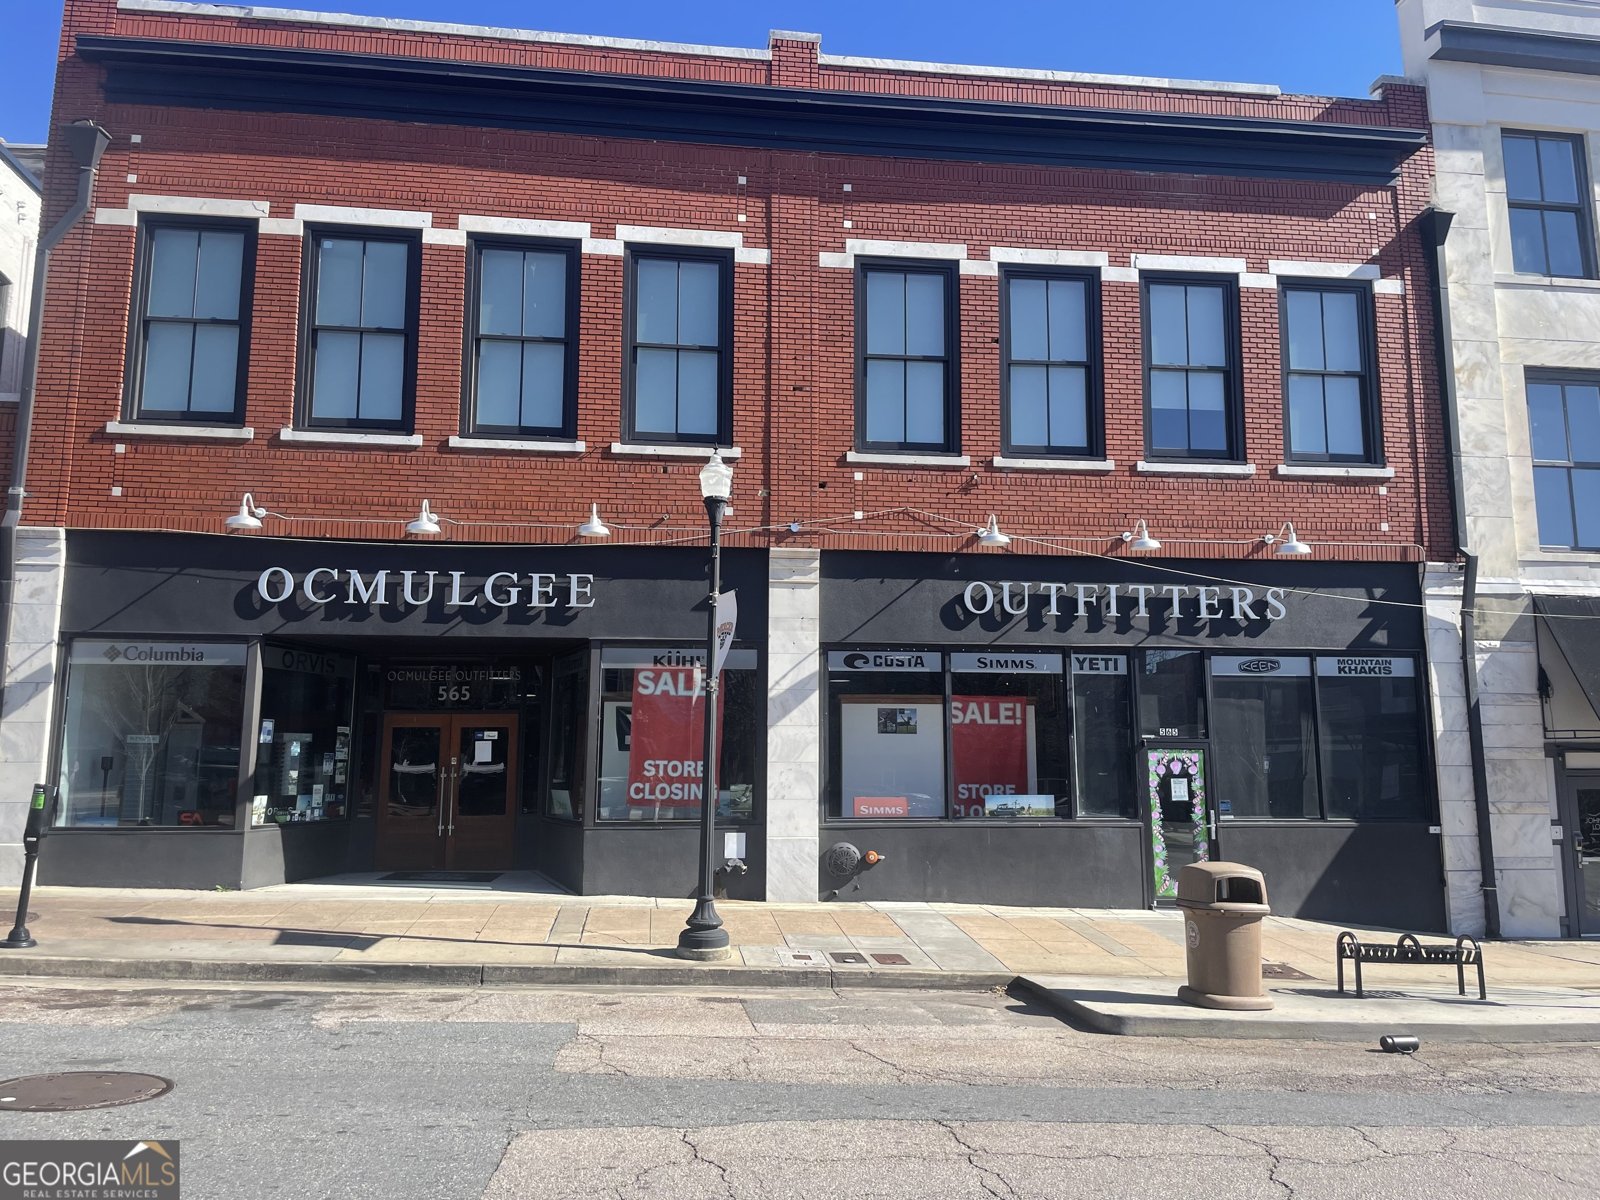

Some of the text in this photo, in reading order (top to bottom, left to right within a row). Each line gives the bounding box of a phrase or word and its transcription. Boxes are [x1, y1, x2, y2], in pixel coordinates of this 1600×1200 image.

[257, 567, 596, 607] OCMULGEE
[963, 581, 1287, 620] OUTFITTERS
[123, 646, 205, 662] Columbia
[282, 651, 336, 673] ORVIS
[873, 655, 925, 668] COSTA
[977, 657, 1035, 670] SIMMS
[1075, 657, 1120, 671] YETI
[1239, 659, 1279, 673] KEEN
[387, 670, 521, 681] OCMULGEE OUTFITTERS
[1337, 666, 1393, 675] KHAKIS
[438, 686, 470, 701] 565
[952, 701, 1023, 725] SALE!
[1159, 728, 1178, 736] 565
[643, 760, 704, 777] STORE
[629, 783, 718, 801] CLOSIN
[860, 805, 903, 815] SIMMS
